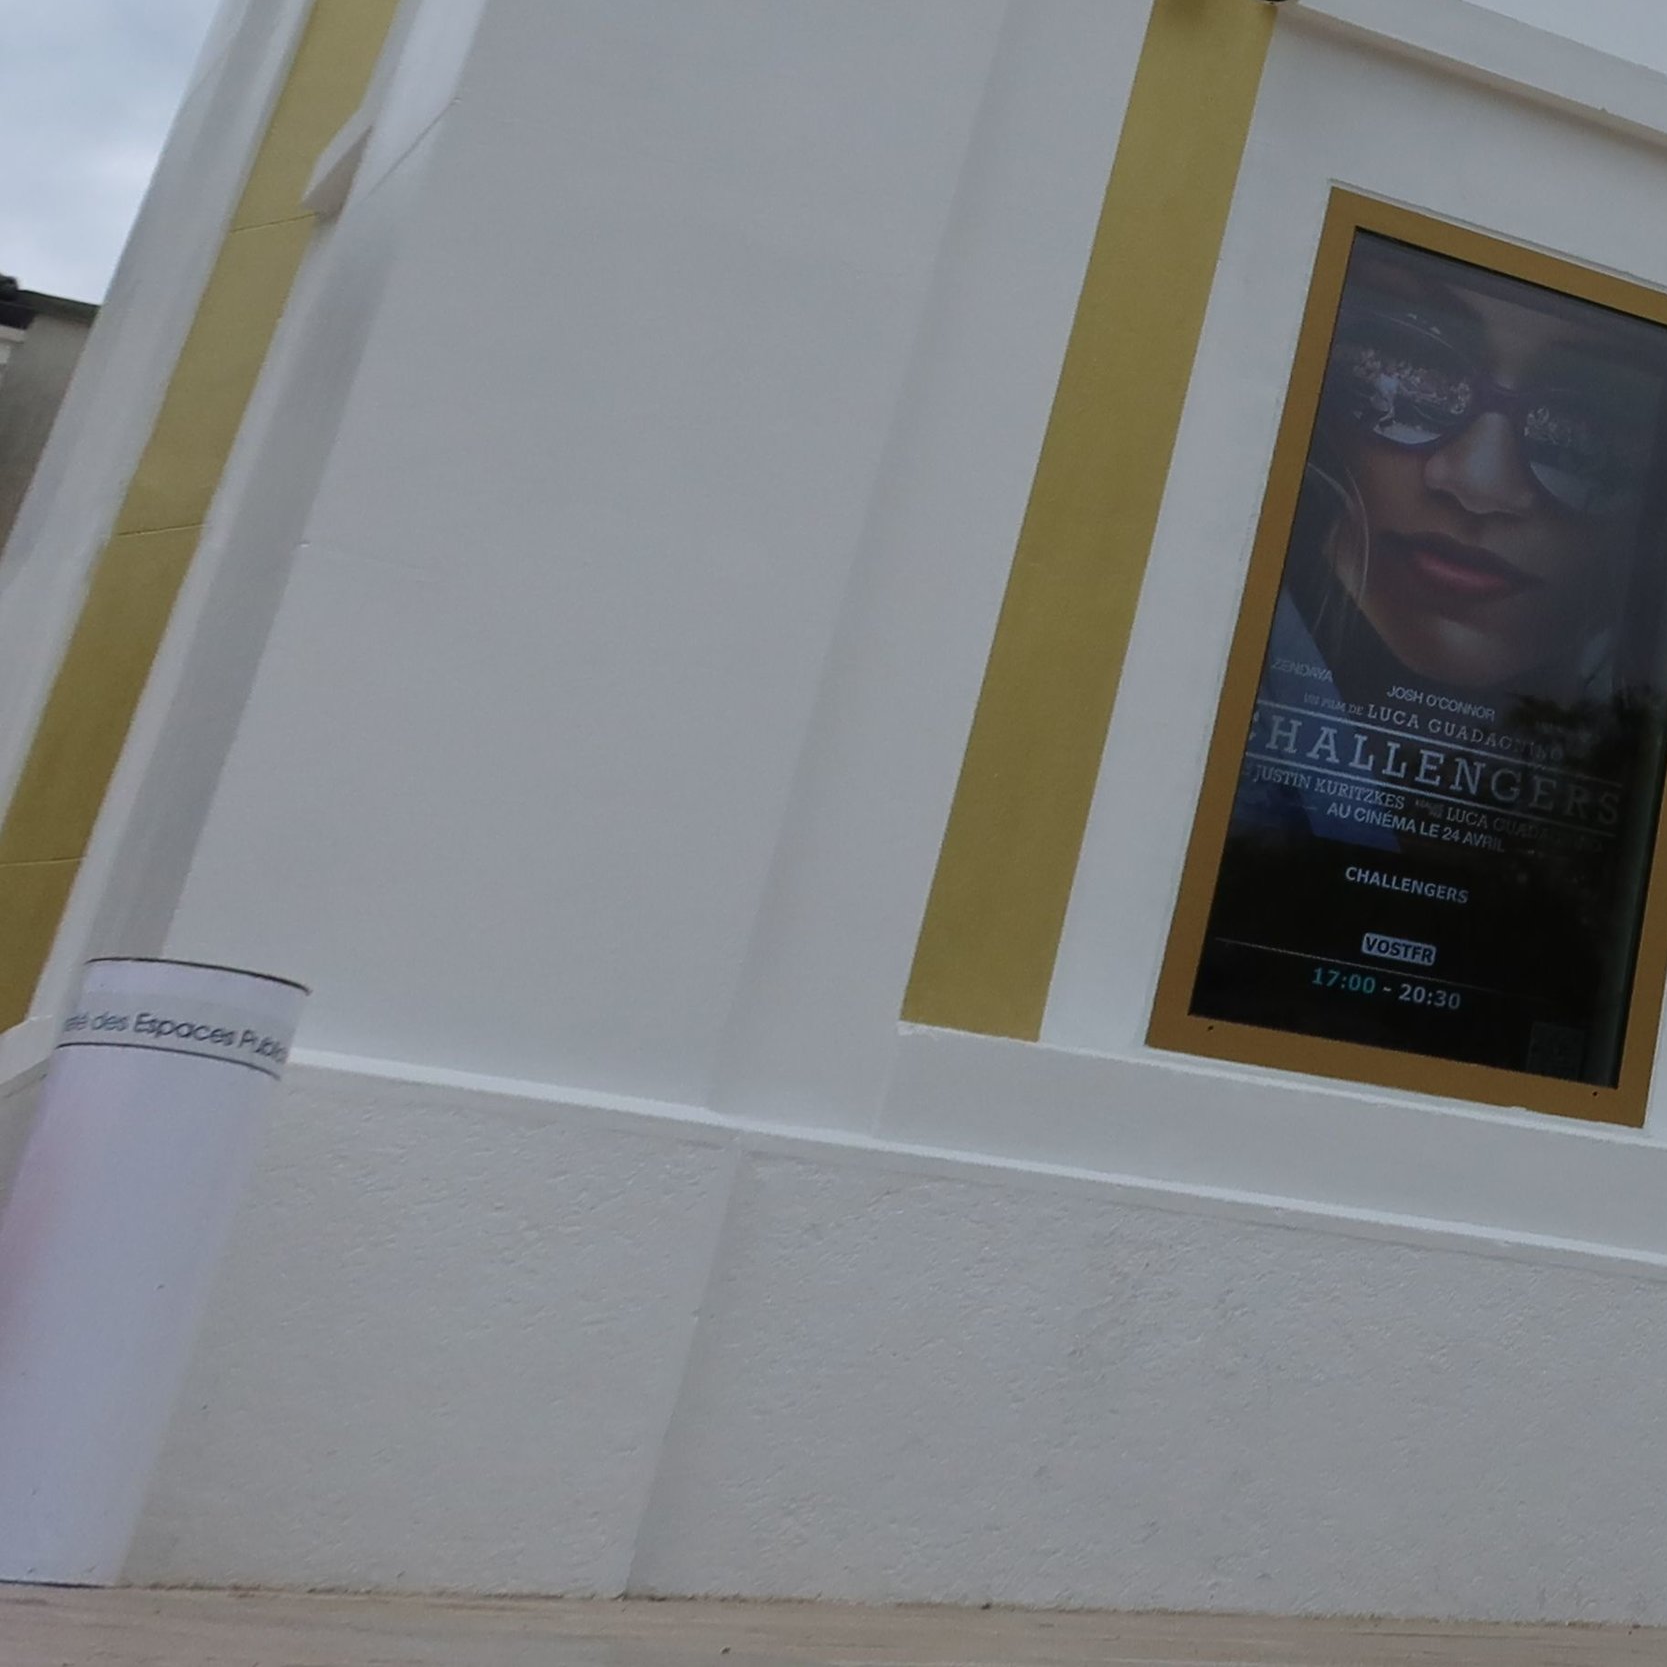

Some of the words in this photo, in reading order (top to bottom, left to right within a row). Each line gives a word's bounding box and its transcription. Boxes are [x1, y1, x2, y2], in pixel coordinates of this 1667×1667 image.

[1367, 703, 1421, 730] LUCA
[1386, 684, 1424, 704] JOSH
[1426, 694, 1496, 722] O'CONNOR
[1247, 709, 1621, 826] HALLENGERS
[1253, 764, 1312, 790] JUSTIN
[1314, 778, 1406, 811] KURITZKES
[1446, 806, 1489, 831] LUCA
[1327, 802, 1352, 821] AU
[1353, 806, 1418, 834] CINÉMA
[1420, 820, 1441, 838] LE
[1442, 825, 1460, 843] 24
[1461, 830, 1505, 854] AVRIL
[1344, 865, 1470, 905] CHALLENGERS
[1364, 934, 1434, 964] VOSTFR
[1311, 966, 1376, 995] 17:00
[1397, 982, 1461, 1011] 20:30
[91, 1010, 130, 1032] des
[133, 1012, 235, 1047] Espaces
